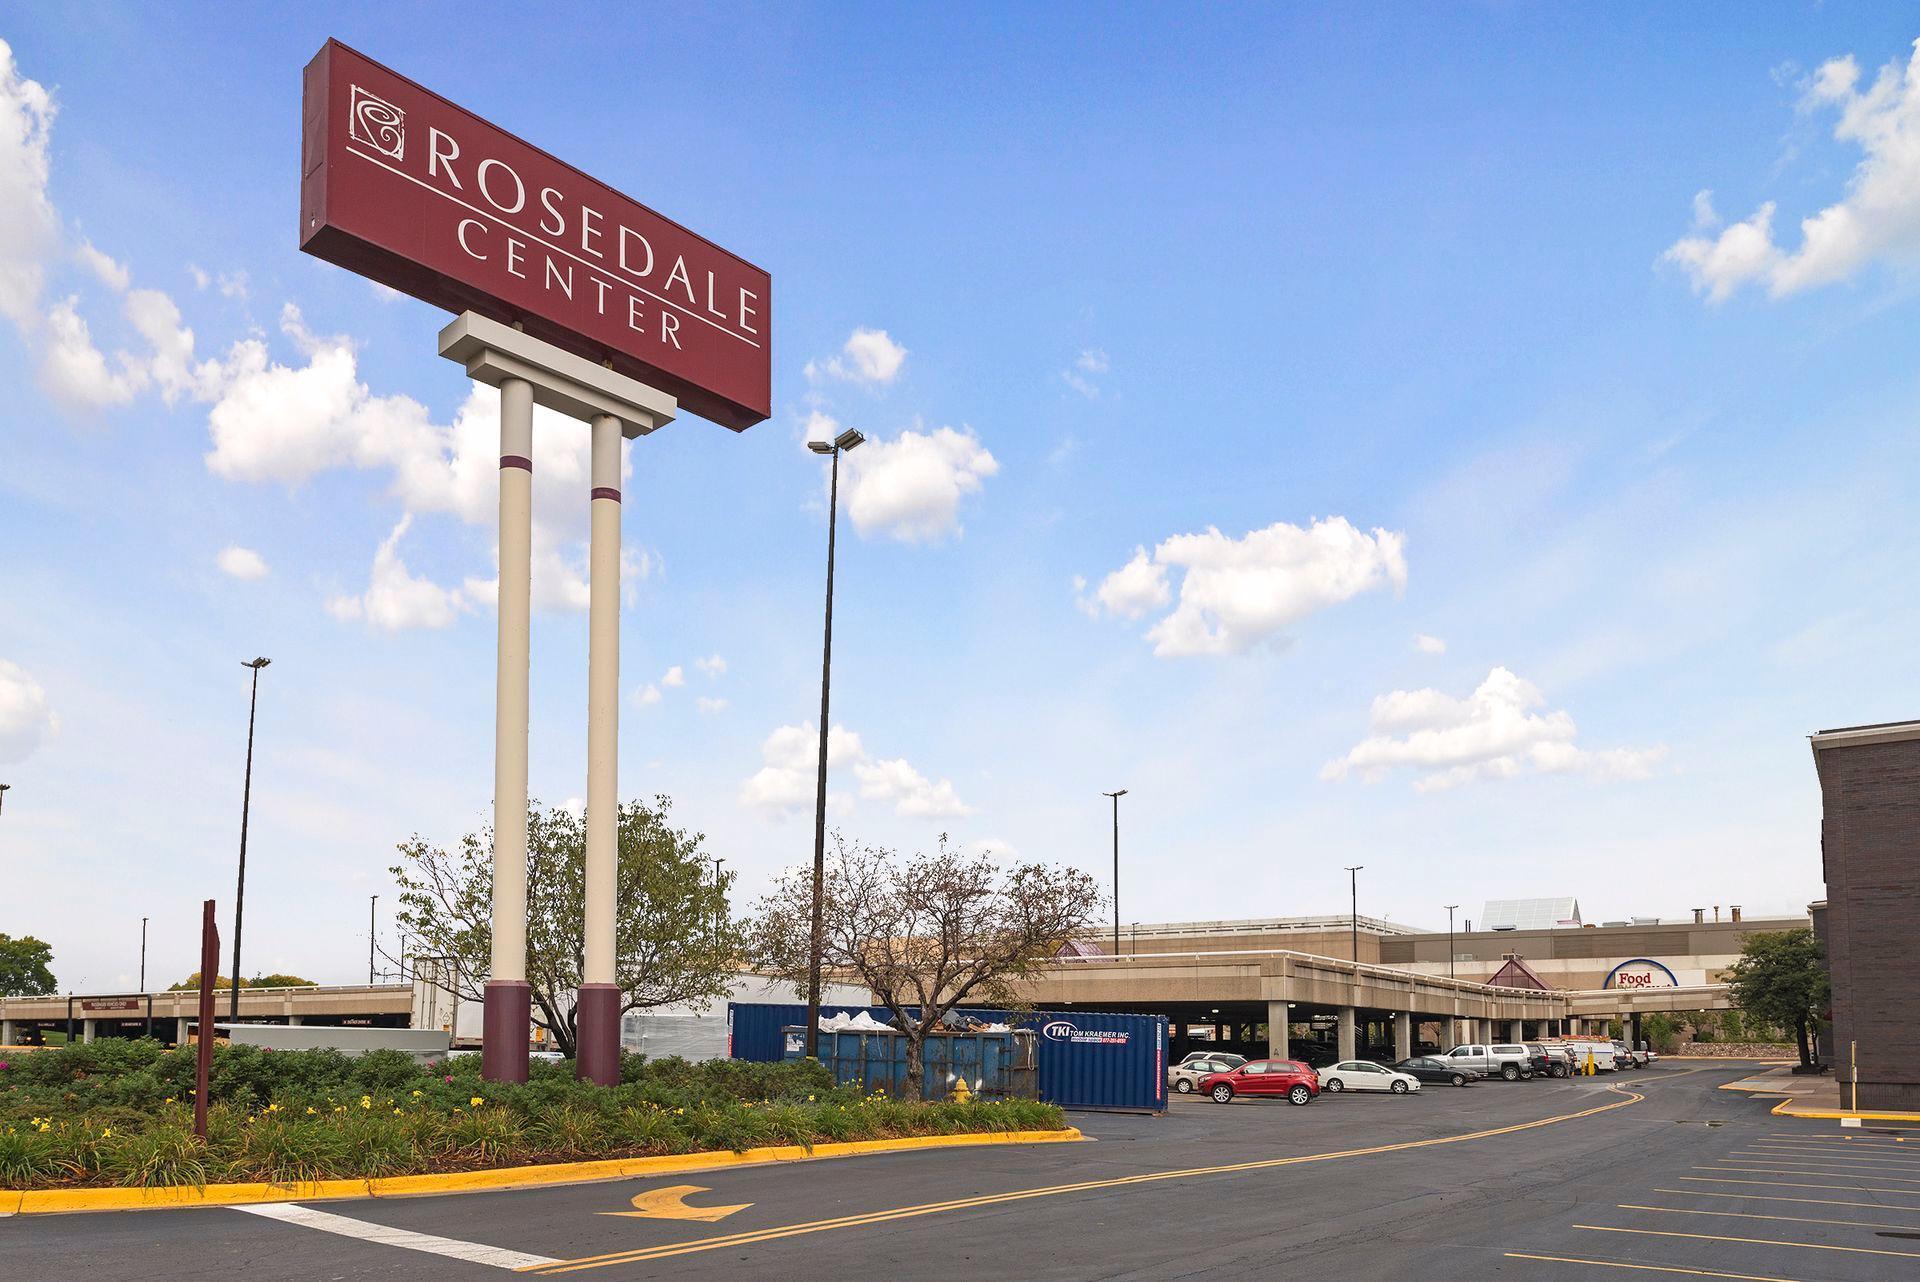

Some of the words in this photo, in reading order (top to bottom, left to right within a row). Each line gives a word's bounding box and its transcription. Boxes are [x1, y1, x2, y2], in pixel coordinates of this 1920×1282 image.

[427, 126, 758, 335] ROSEDALE
[457, 218, 682, 350] CENTER
[1619, 972, 1651, 984] Food
[1051, 1026, 1070, 1037] TKI
[1117, 1031, 1131, 1039] INC.
